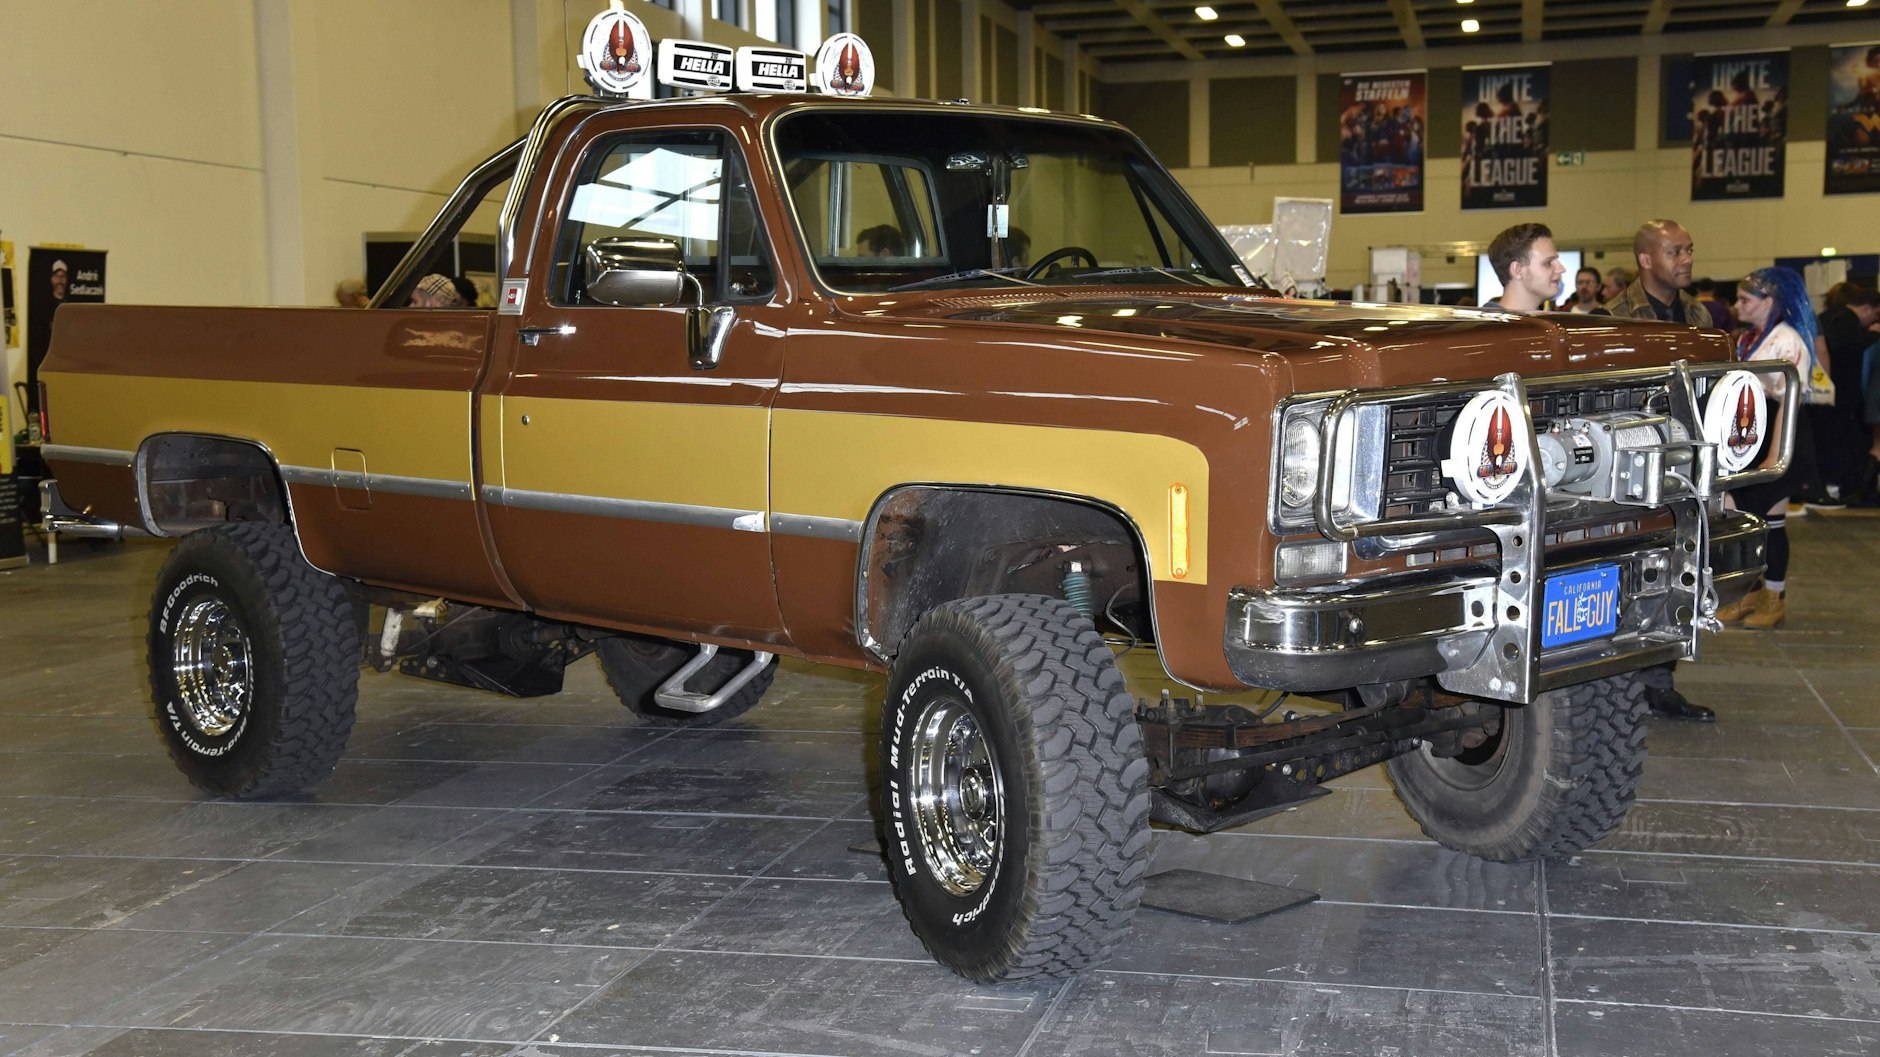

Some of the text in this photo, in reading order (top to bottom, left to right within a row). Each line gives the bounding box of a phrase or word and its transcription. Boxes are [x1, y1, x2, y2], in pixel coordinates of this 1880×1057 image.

[680, 57, 724, 74] HELLA
[758, 63, 798, 78] HELLA
[1712, 60, 1771, 90] UNTE
[1355, 88, 1410, 102] STAFFELN
[1478, 73, 1533, 102] UNTE
[1488, 115, 1523, 145] THE
[1722, 104, 1759, 134] THE
[1470, 157, 1539, 188] LEAGUE
[1701, 147, 1776, 177] LEAGUE
[1564, 579, 1602, 596] CALIFORNIA
[159, 572, 219, 634] BFGoodrich
[1547, 597, 1582, 637] FALL
[1586, 588, 1614, 628] GUY
[890, 665, 950, 770] Mud-Terrain
[890, 780, 917, 876] Radial
